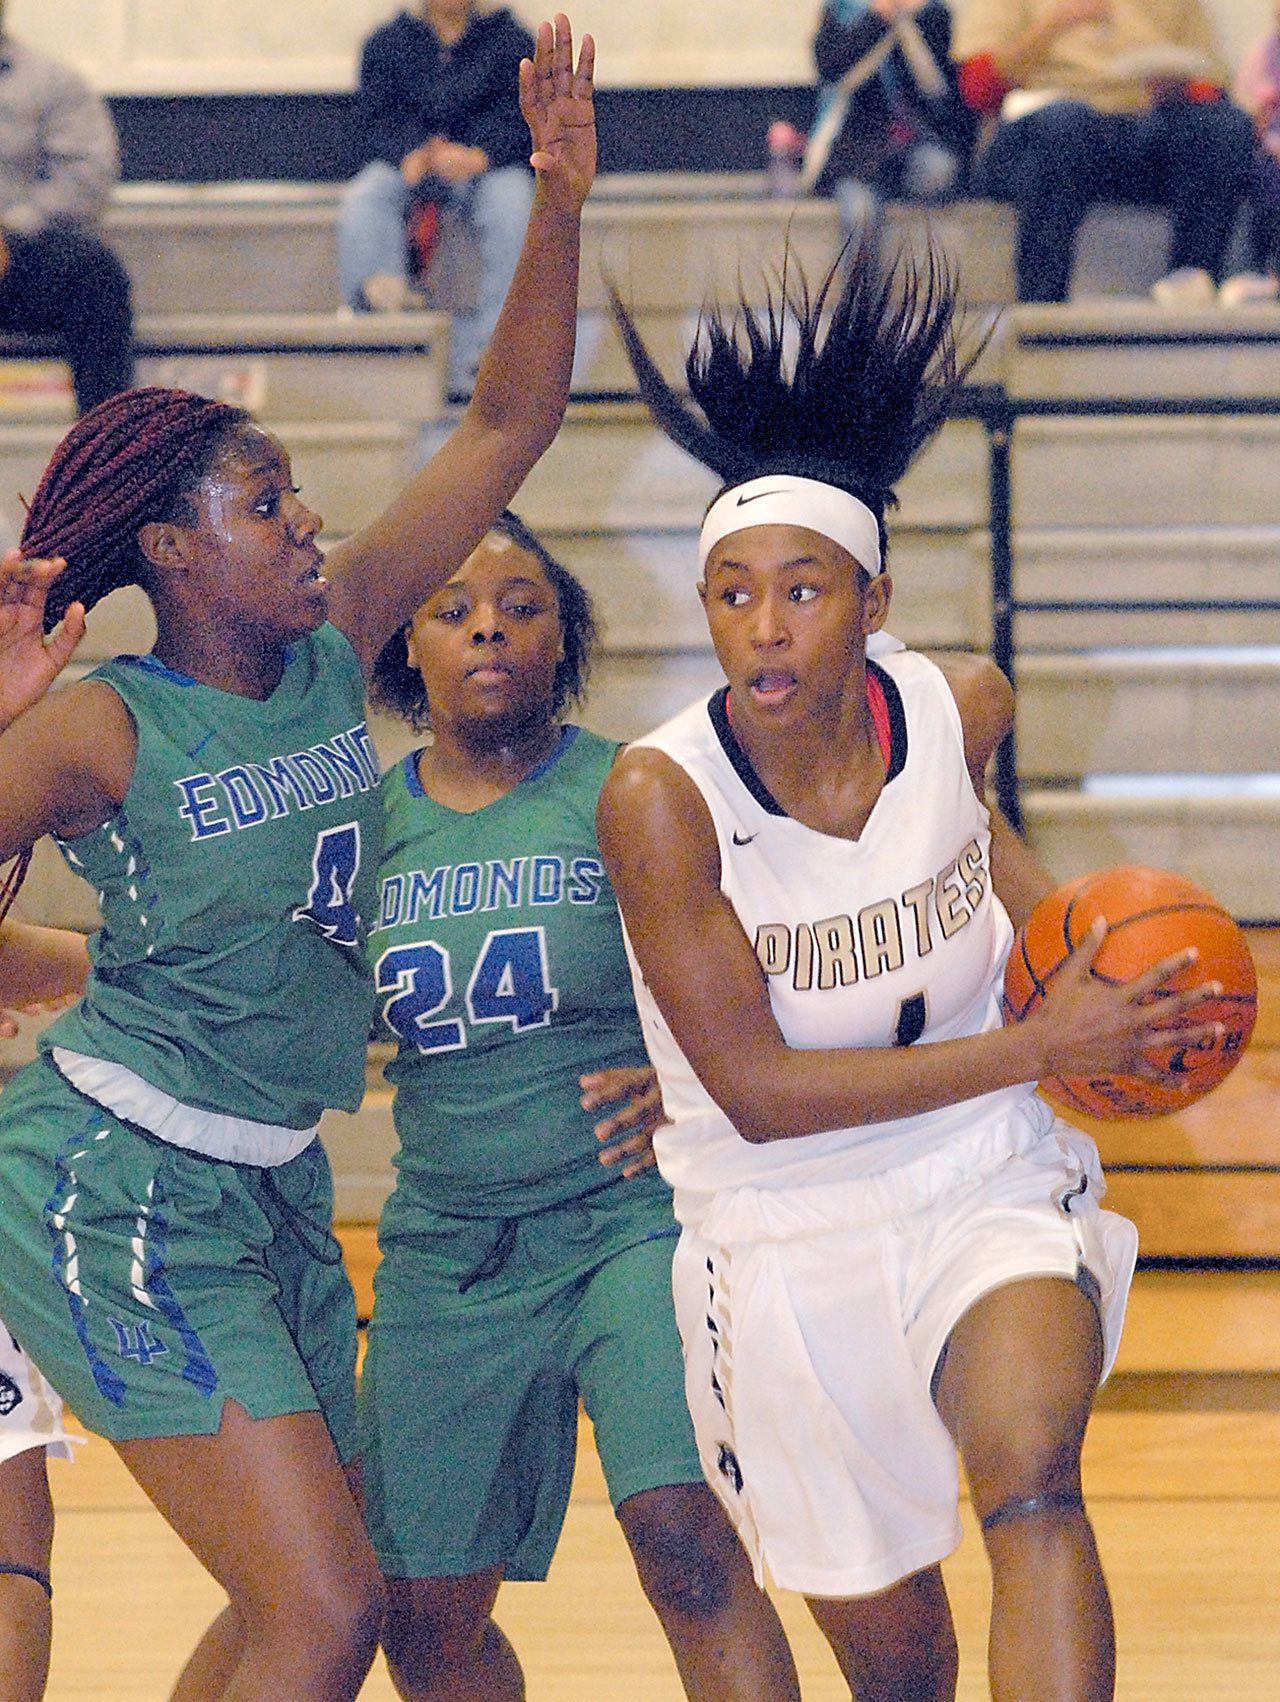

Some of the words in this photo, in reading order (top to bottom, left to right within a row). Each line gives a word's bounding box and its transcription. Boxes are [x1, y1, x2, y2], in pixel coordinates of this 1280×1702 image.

[292, 821, 361, 946] 4
[367, 855, 603, 937] DMONDS
[754, 838, 988, 992] PIRATES
[375, 926, 559, 1054] 24
